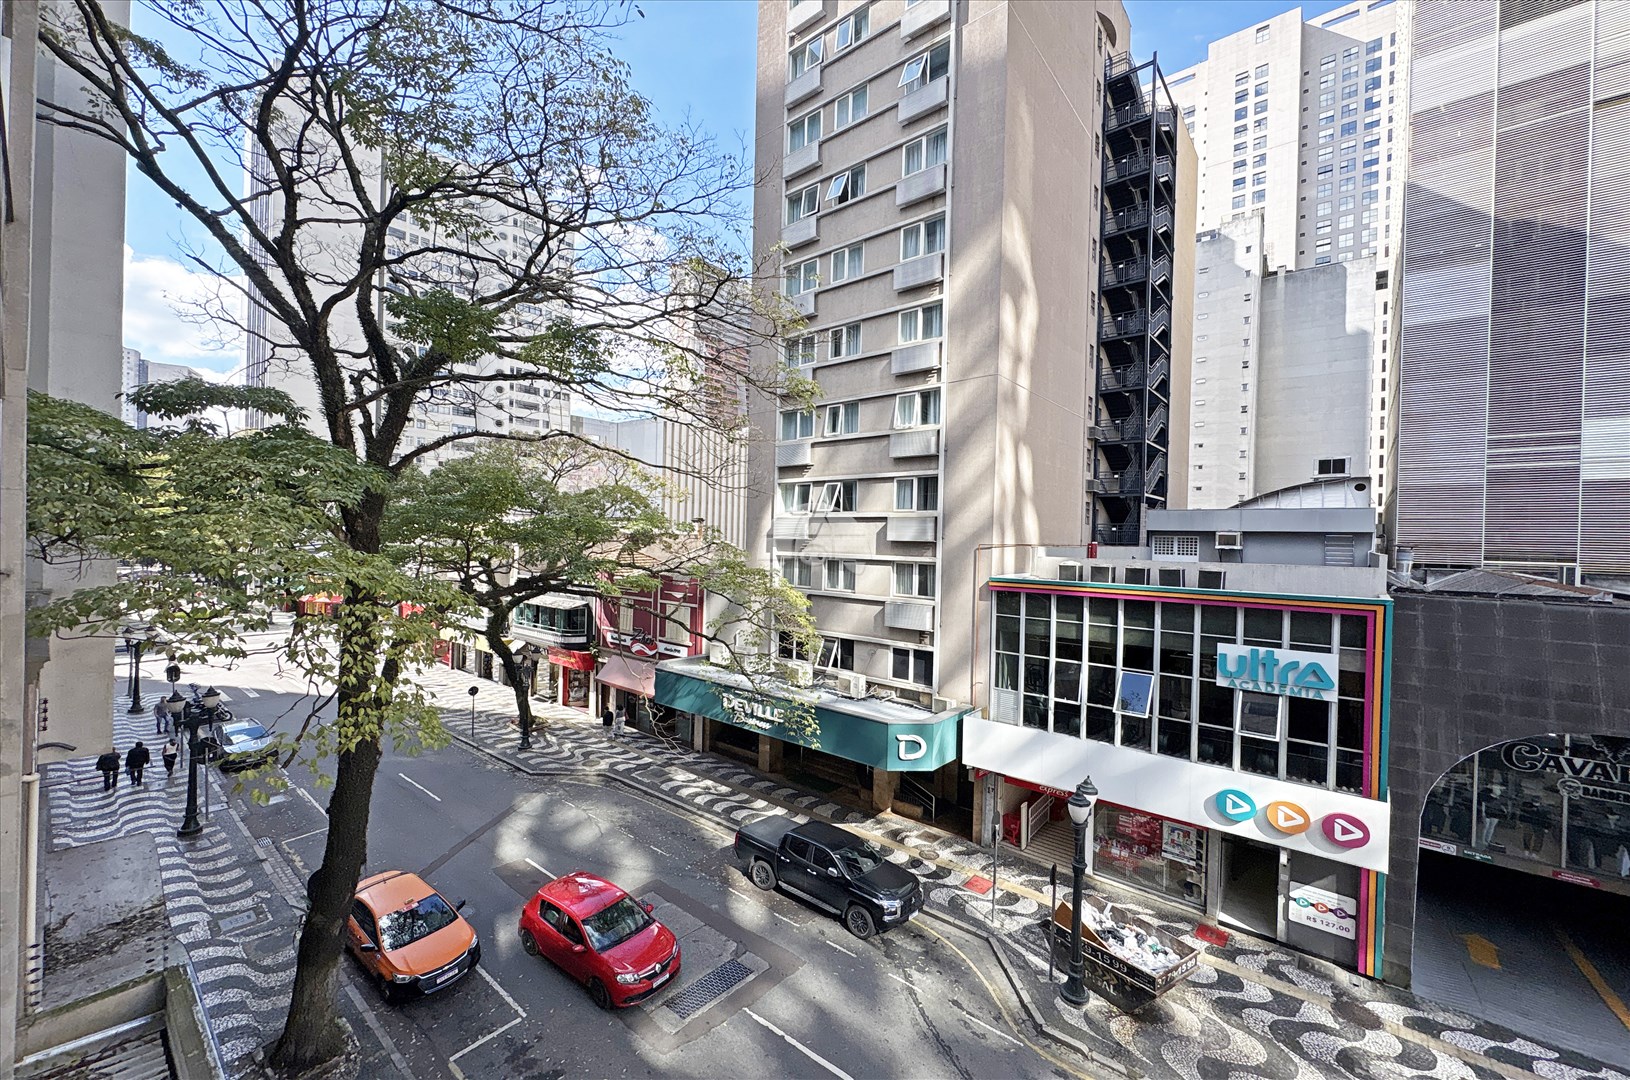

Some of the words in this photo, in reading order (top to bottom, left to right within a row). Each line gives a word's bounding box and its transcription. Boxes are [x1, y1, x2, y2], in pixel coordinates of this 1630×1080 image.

[1227, 678, 1324, 700] ACADEMIA
[722, 693, 785, 723] DEVILLE
[895, 734, 927, 761] D
[1039, 784, 1069, 798] express
